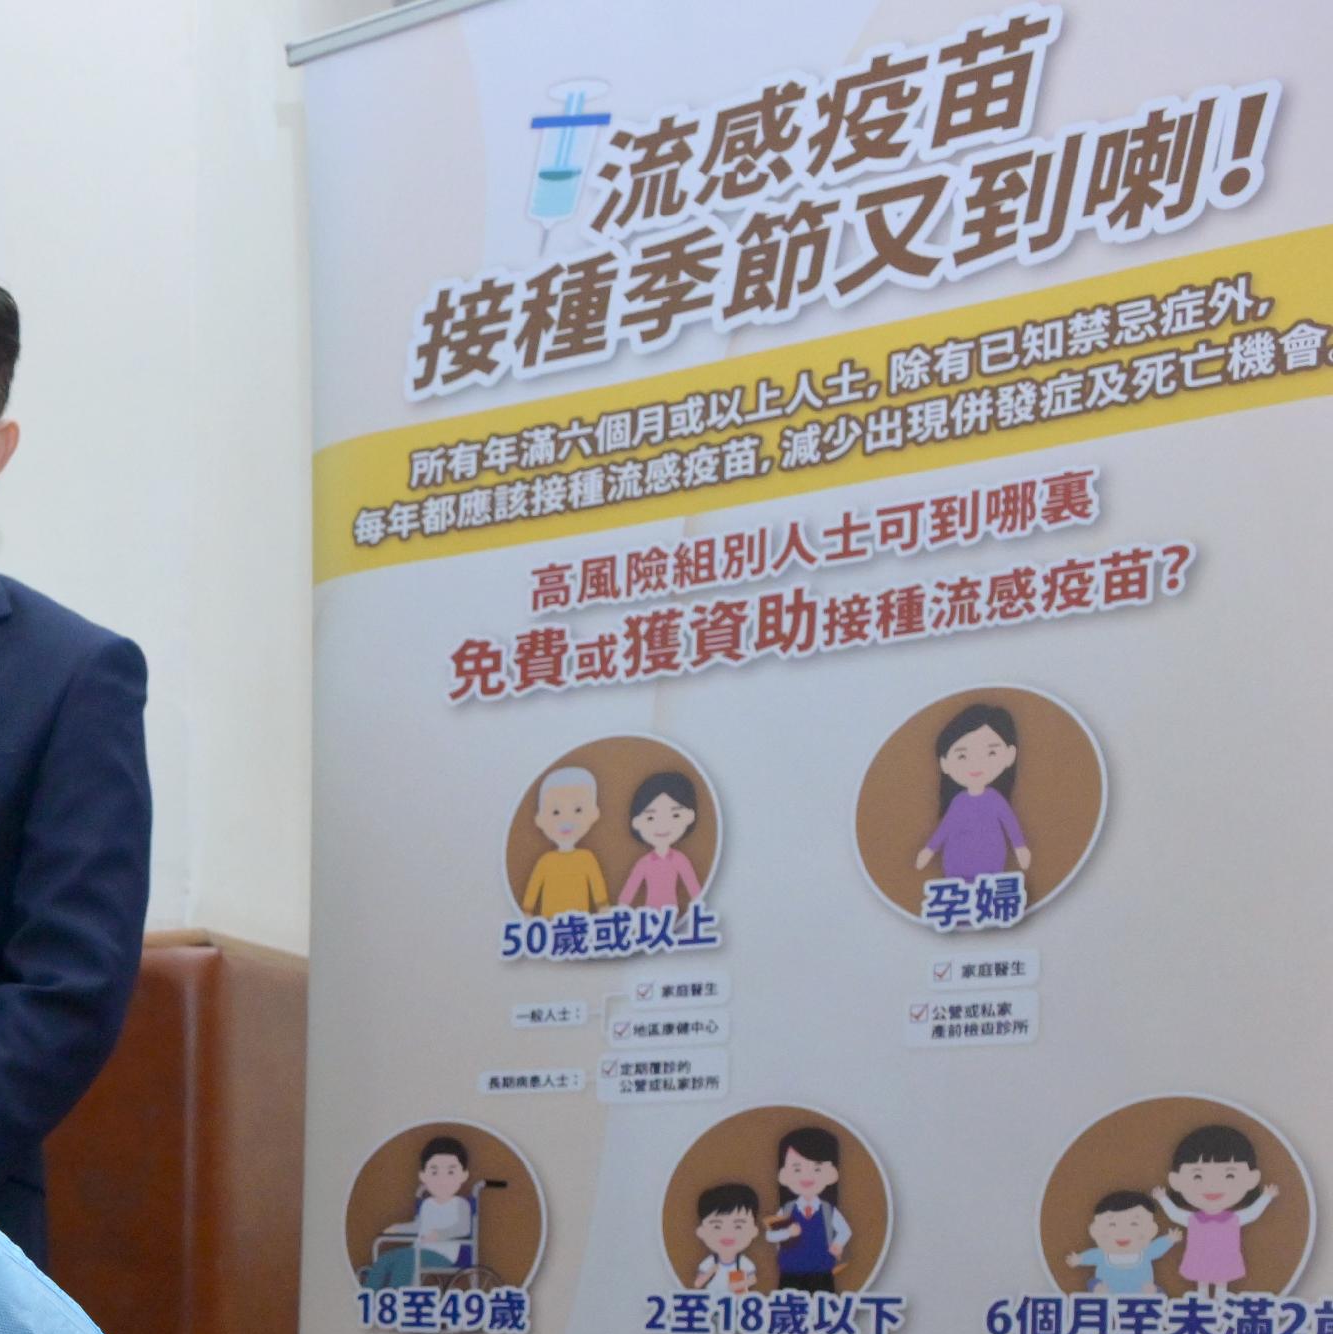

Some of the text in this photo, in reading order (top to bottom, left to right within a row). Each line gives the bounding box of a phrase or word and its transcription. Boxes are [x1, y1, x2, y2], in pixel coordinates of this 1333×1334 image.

[590, 15, 1050, 234] 流感疫苗
[413, 92, 1268, 392] 接種季節又到喇!
[531, 469, 1095, 610] 高風險組別人士可到哪裏
[448, 544, 1195, 702] 免費或獲資助接種流感疫苗?
[927, 877, 1022, 927] 孕婦
[502, 904, 717, 956] 50歲或以上
[961, 960, 1026, 978] 家庭醫生
[661, 982, 718, 998] 家庭醫生
[633, 1019, 719, 1037] 地區康健中心
[932, 1002, 1012, 1020] 公營或私家
[620, 1060, 691, 1076] 定期覆診的
[620, 1076, 719, 1094] 公營或私家診所
[357, 1290, 526, 1331] 18至49歲
